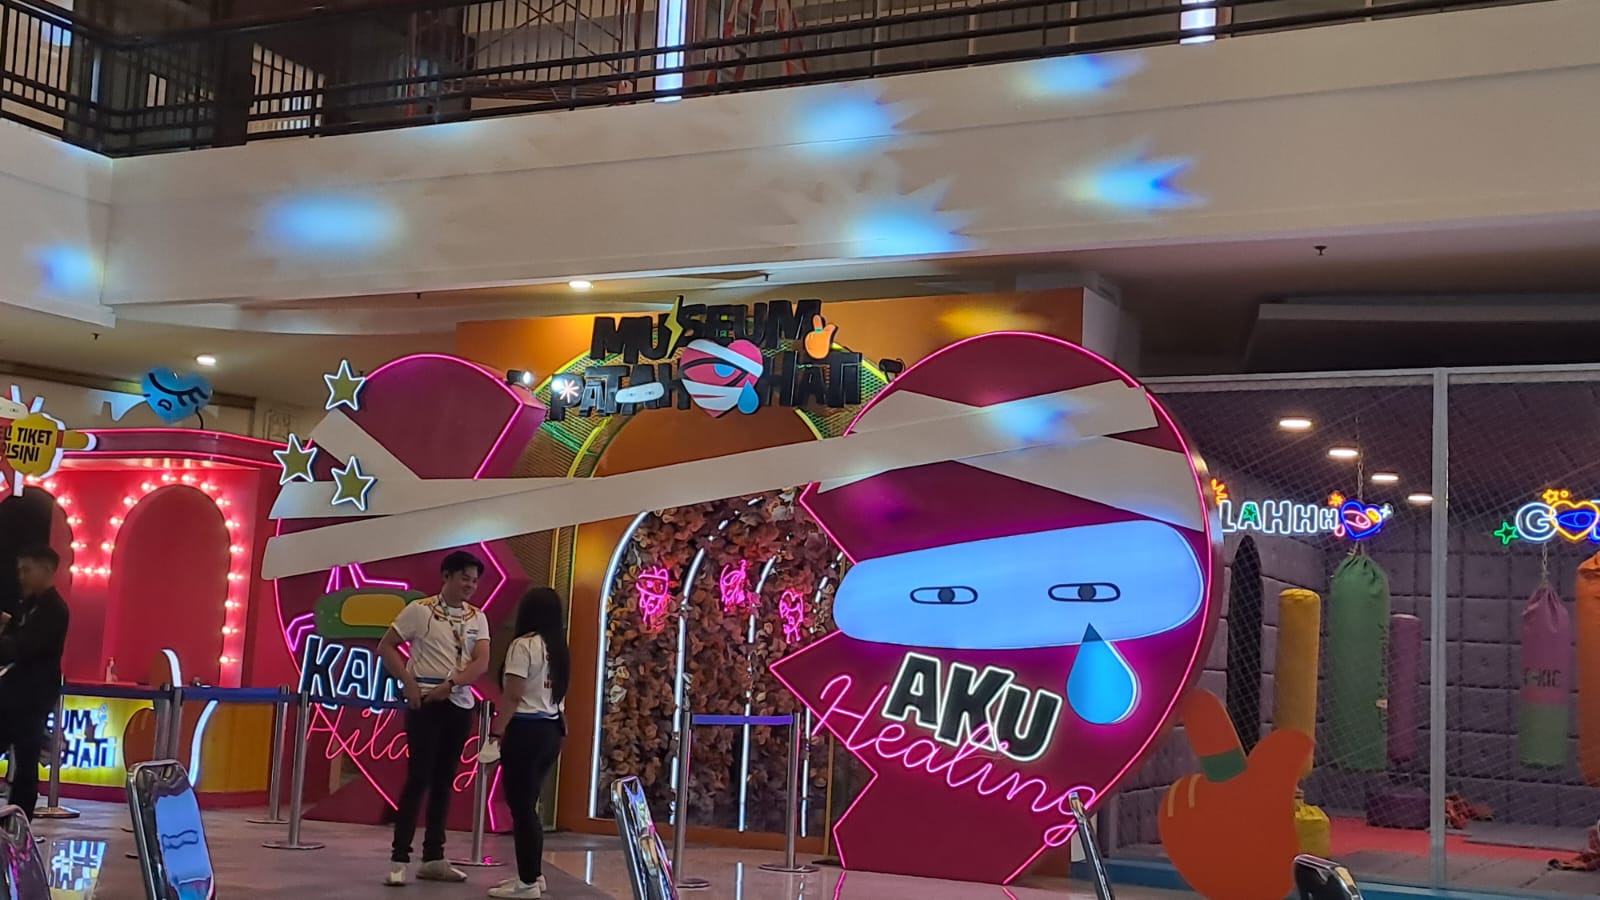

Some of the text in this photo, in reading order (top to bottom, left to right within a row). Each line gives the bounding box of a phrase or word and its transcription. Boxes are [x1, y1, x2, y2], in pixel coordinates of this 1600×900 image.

[589, 299, 822, 364] MUSEUM
[550, 350, 863, 422] PATAH HATI
[17, 427, 53, 446] TIKET
[882, 652, 1064, 762] AKU
[811, 675, 1097, 847] Healing
